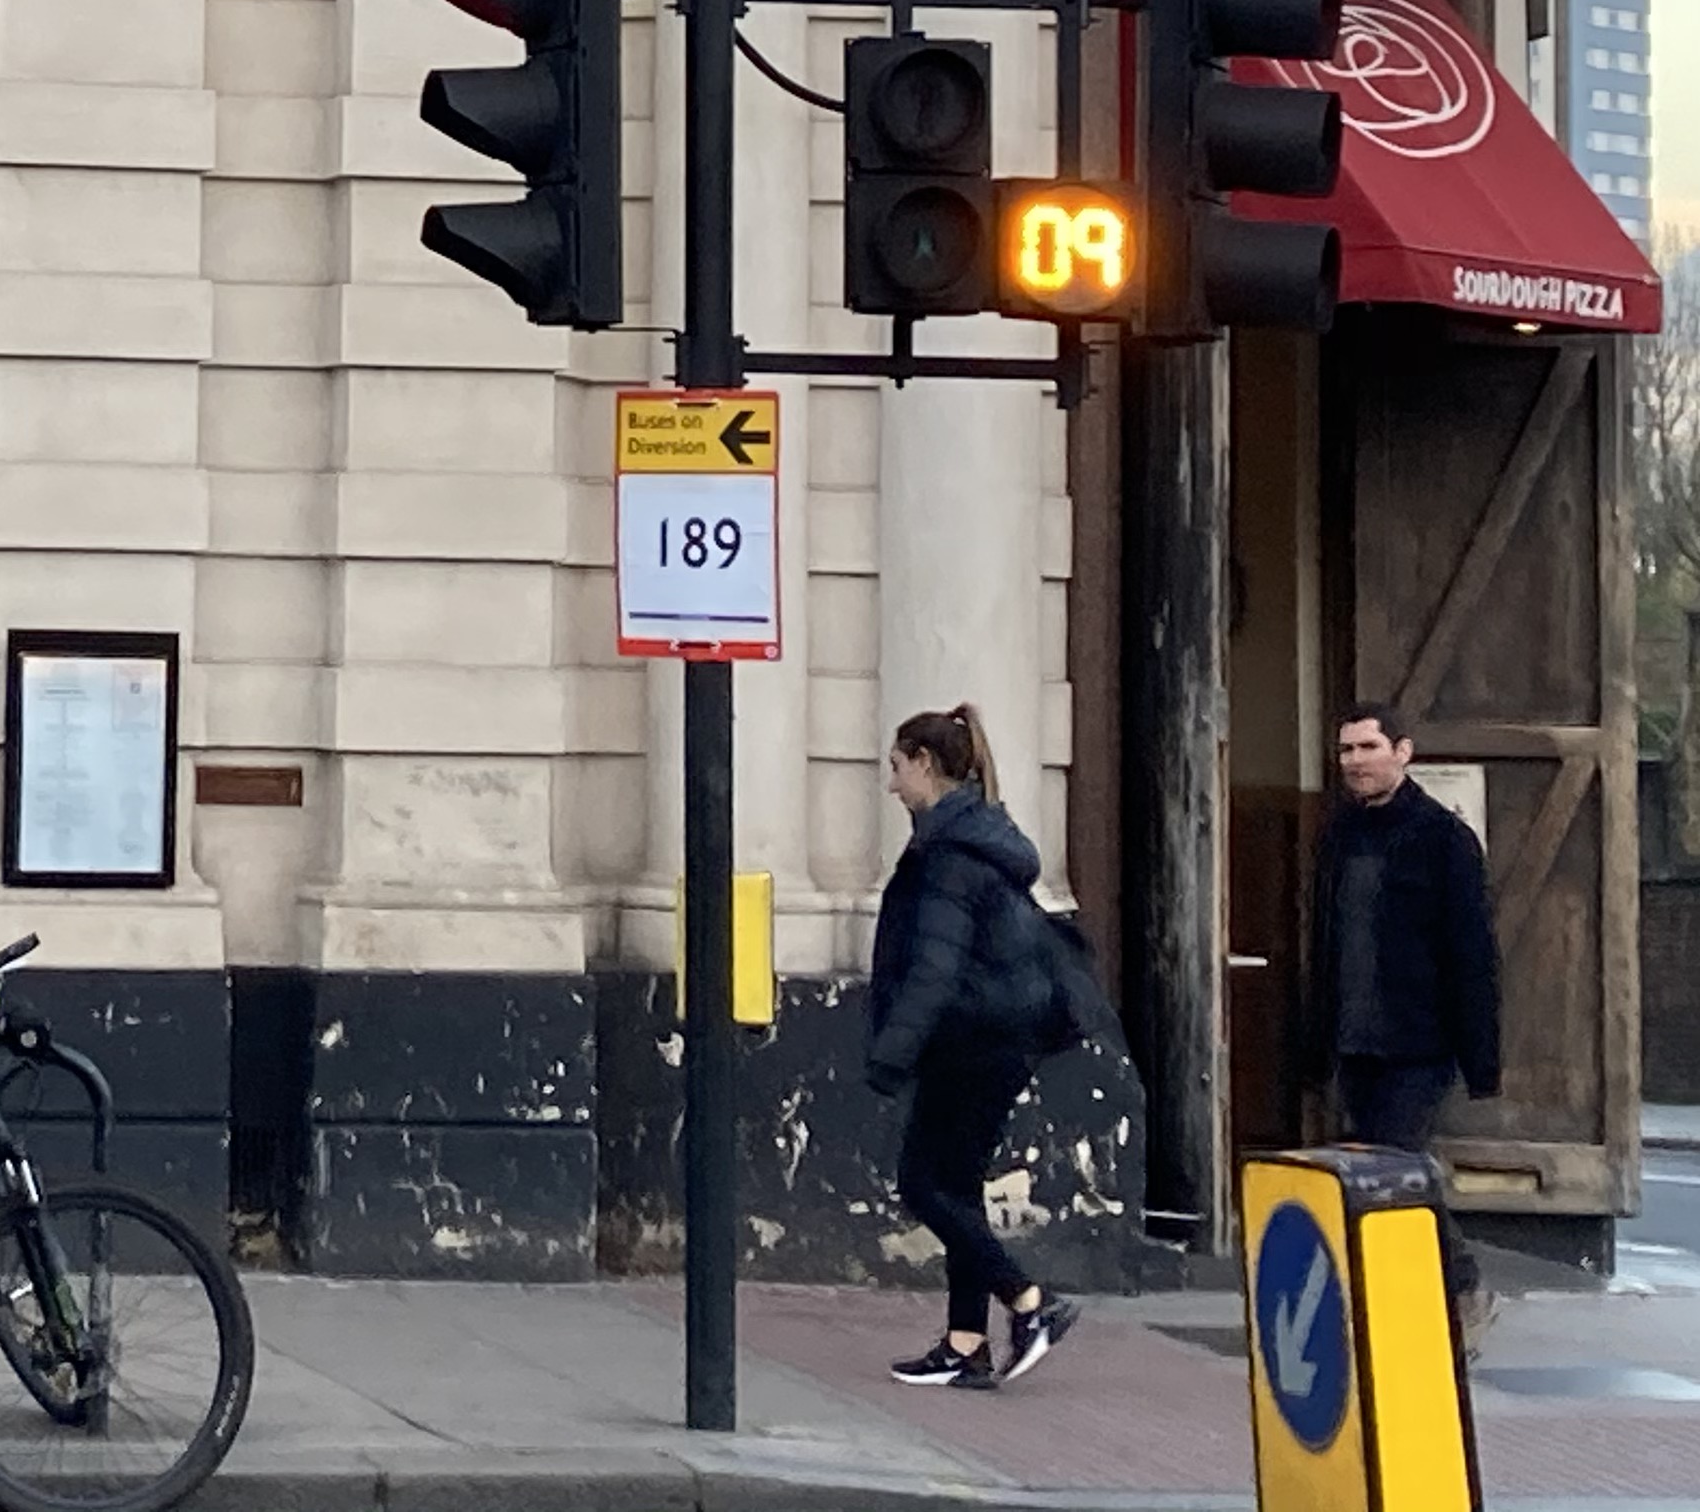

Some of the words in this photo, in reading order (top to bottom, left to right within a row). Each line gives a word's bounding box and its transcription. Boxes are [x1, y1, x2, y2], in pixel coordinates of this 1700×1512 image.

[1020, 203, 1124, 290] 09
[1452, 265, 1563, 312] SOURDOUGH
[1564, 279, 1624, 321] PIZZA
[627, 436, 707, 455] Diversion
[628, 412, 676, 429] Buses
[681, 414, 702, 429] on
[659, 517, 742, 569] 189
